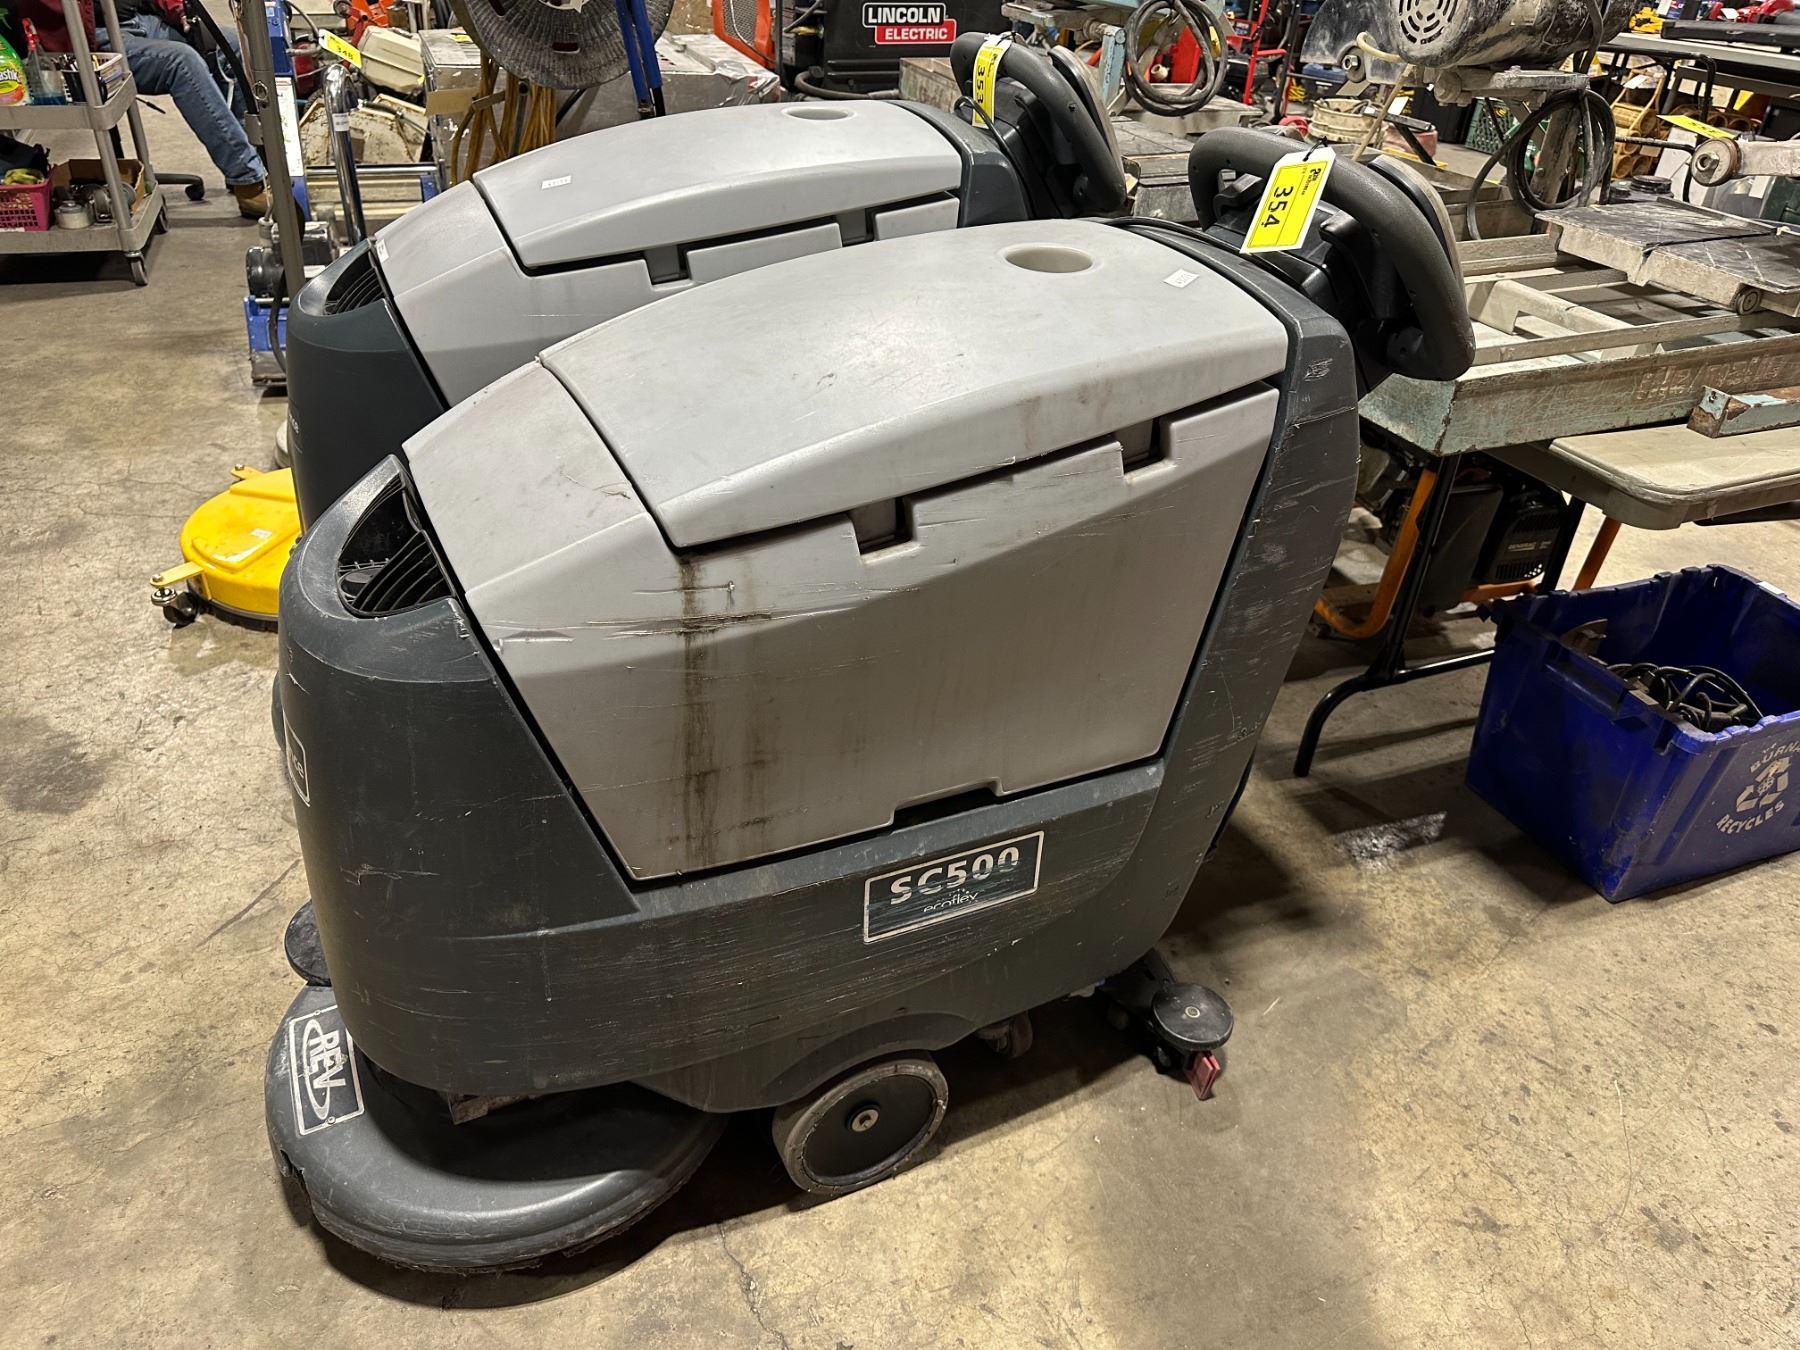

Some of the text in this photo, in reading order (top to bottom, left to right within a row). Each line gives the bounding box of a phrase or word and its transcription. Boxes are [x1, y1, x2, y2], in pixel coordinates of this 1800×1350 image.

[867, 7, 941, 24] LINCOLN
[884, 27, 949, 41] ELECTRIC
[976, 64, 986, 104] 353
[1261, 185, 1295, 228] 354
[1716, 799, 1785, 835] RECYCLES
[889, 846, 1020, 906] SC500
[308, 1029, 348, 1090] REV
